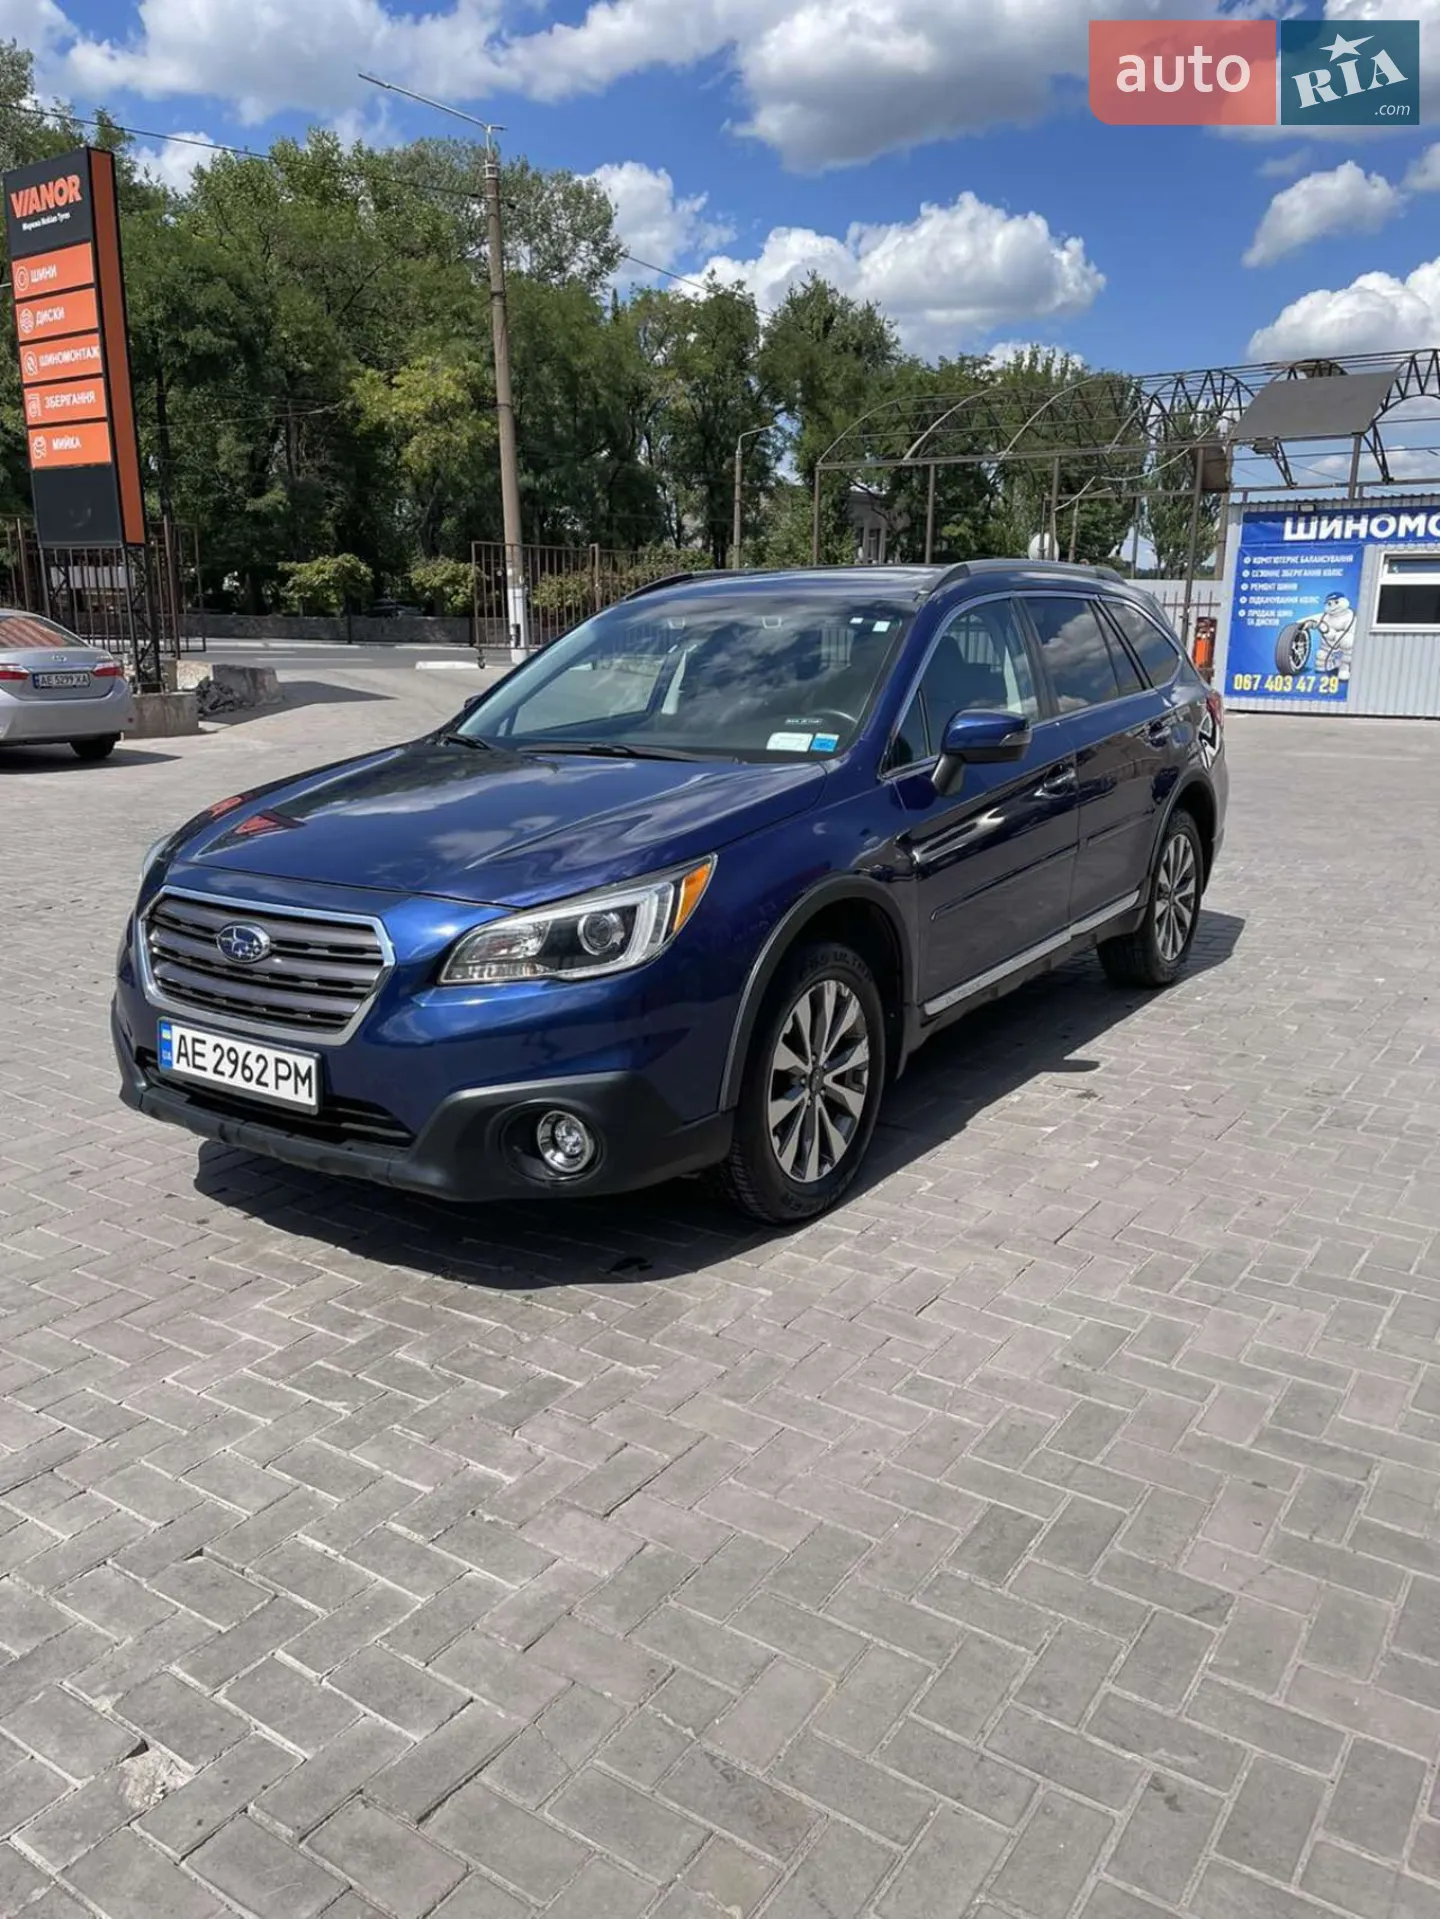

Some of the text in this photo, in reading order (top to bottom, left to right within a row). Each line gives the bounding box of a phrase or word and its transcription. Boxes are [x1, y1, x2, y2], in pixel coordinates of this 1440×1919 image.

[10, 174, 82, 218] VIANOR
[30, 264, 57, 283] ШИНИ
[35, 306, 65, 326] ДИСКИ
[39, 345, 100, 367] ШИНОМОНТАЖ
[52, 435, 81, 450] МИЙКА
[41, 675, 53, 685] AE
[1233, 674, 1339, 693] 067 403 47 29
[176, 1034, 313, 1098] AE 2962 PM
